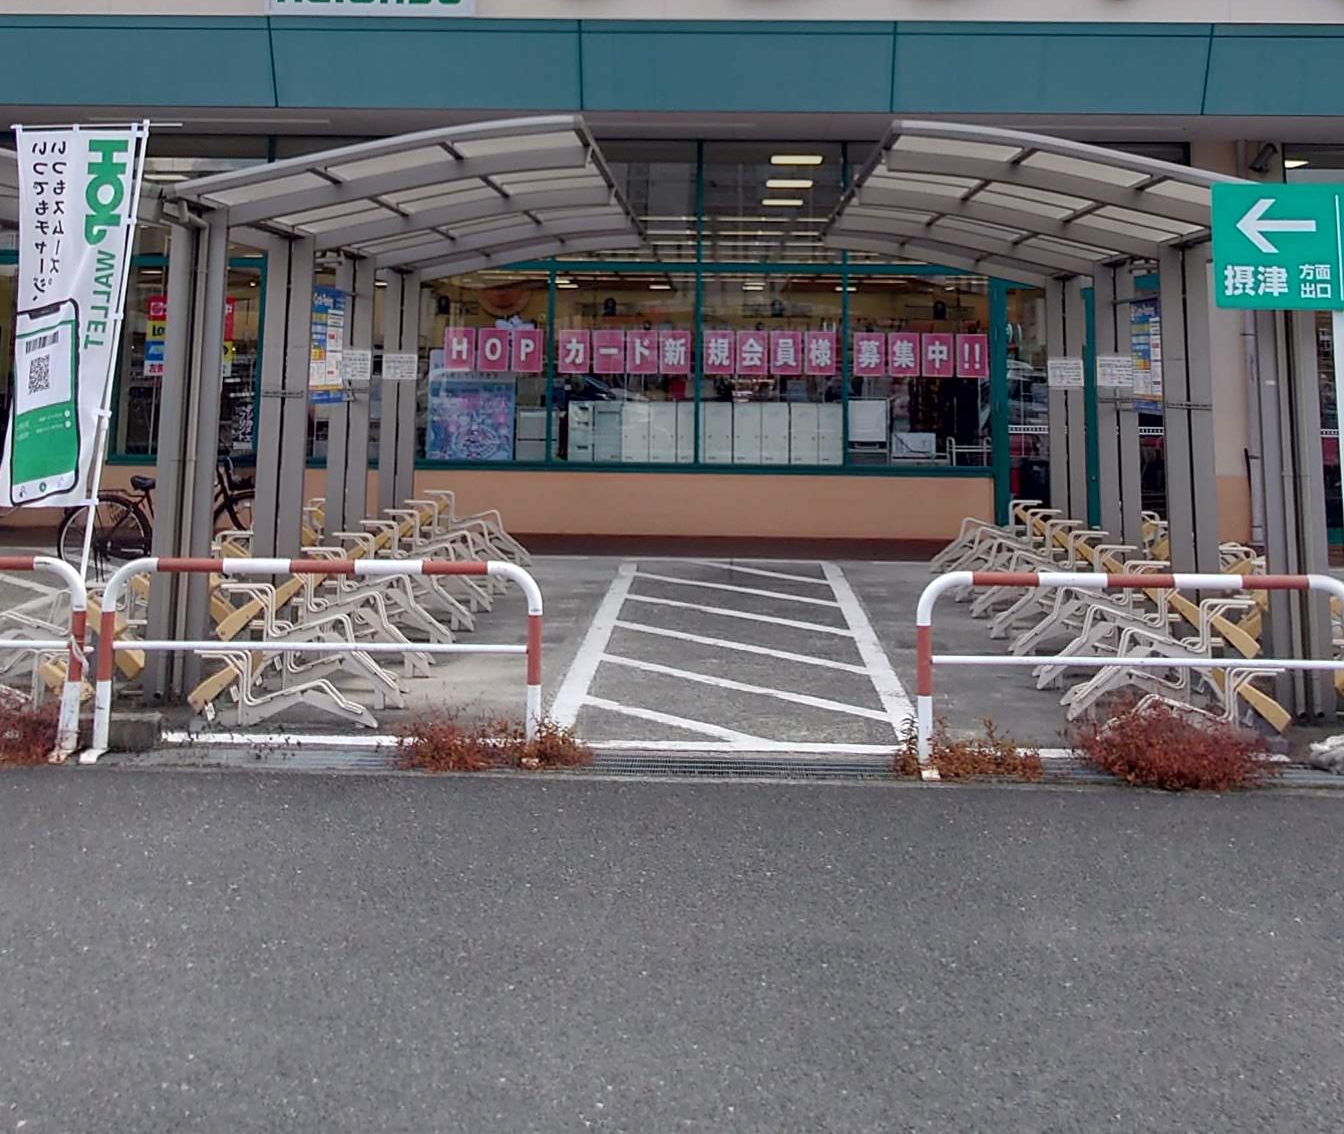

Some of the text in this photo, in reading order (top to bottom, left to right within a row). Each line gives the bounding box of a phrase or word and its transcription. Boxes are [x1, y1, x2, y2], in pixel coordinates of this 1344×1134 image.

[1299, 264, 1331, 280] 方面
[1224, 265, 1289, 298] 摂津
[1300, 283, 1332, 299] 出口
